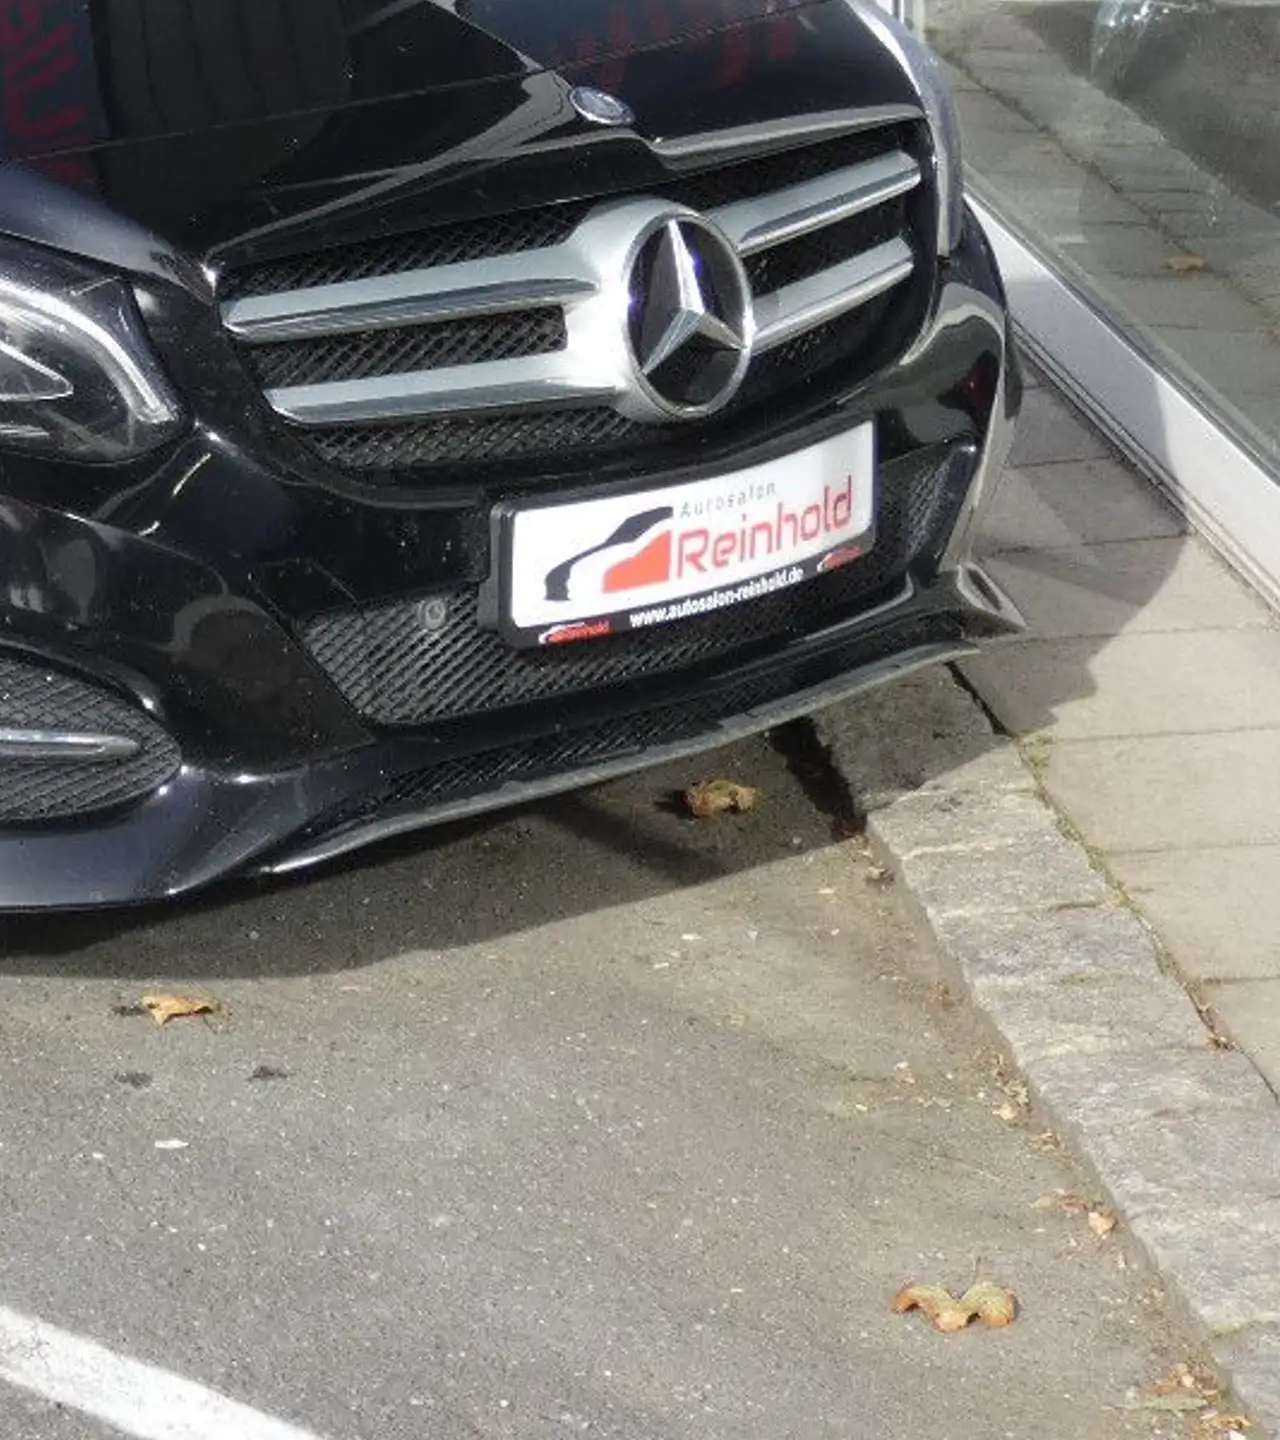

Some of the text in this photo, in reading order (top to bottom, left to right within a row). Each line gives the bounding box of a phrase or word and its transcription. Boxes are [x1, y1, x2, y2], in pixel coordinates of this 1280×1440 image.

[676, 474, 853, 580] Reinhold
[679, 481, 778, 519] Autosalon
[629, 564, 804, 628] www.autosalon-reinhold.de
